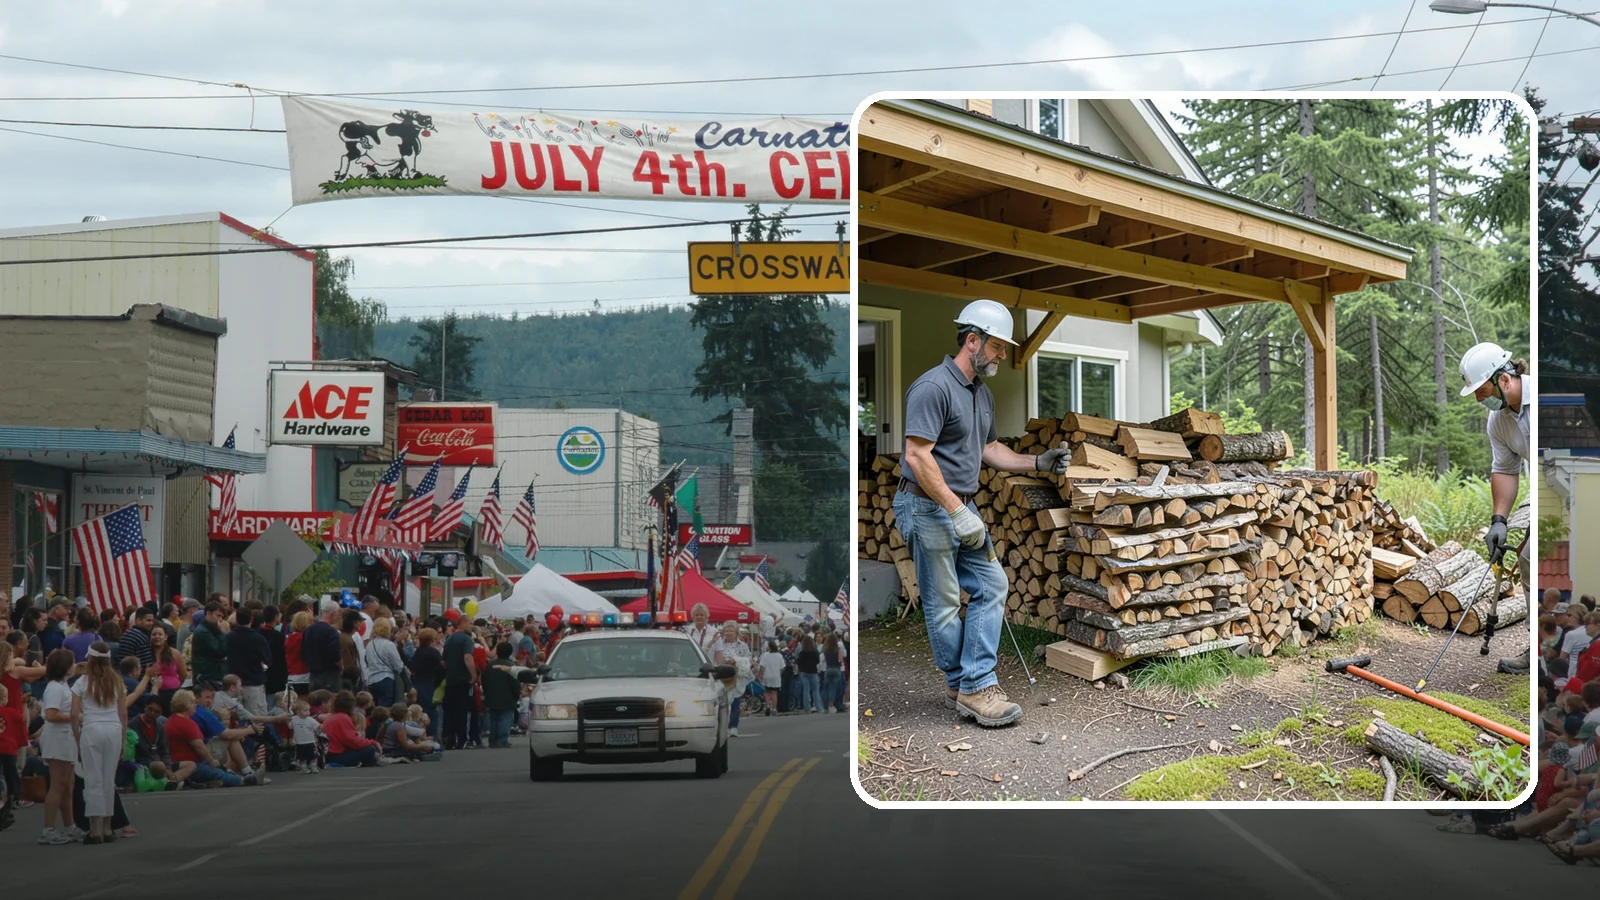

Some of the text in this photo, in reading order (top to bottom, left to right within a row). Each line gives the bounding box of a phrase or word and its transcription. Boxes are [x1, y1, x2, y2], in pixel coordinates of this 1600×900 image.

[695, 121, 850, 150] Carnat
[481, 141, 605, 193] JULY
[632, 150, 746, 198] 4th.
[697, 253, 850, 280] CROSSWA
[282, 380, 373, 420] ACE
[405, 408, 453, 422] CEDAR
[283, 421, 371, 437] Hardware
[83, 484, 155, 496] St. Vincent de Paul
[688, 526, 741, 535] CRNATION
[699, 535, 730, 543] GLASS
